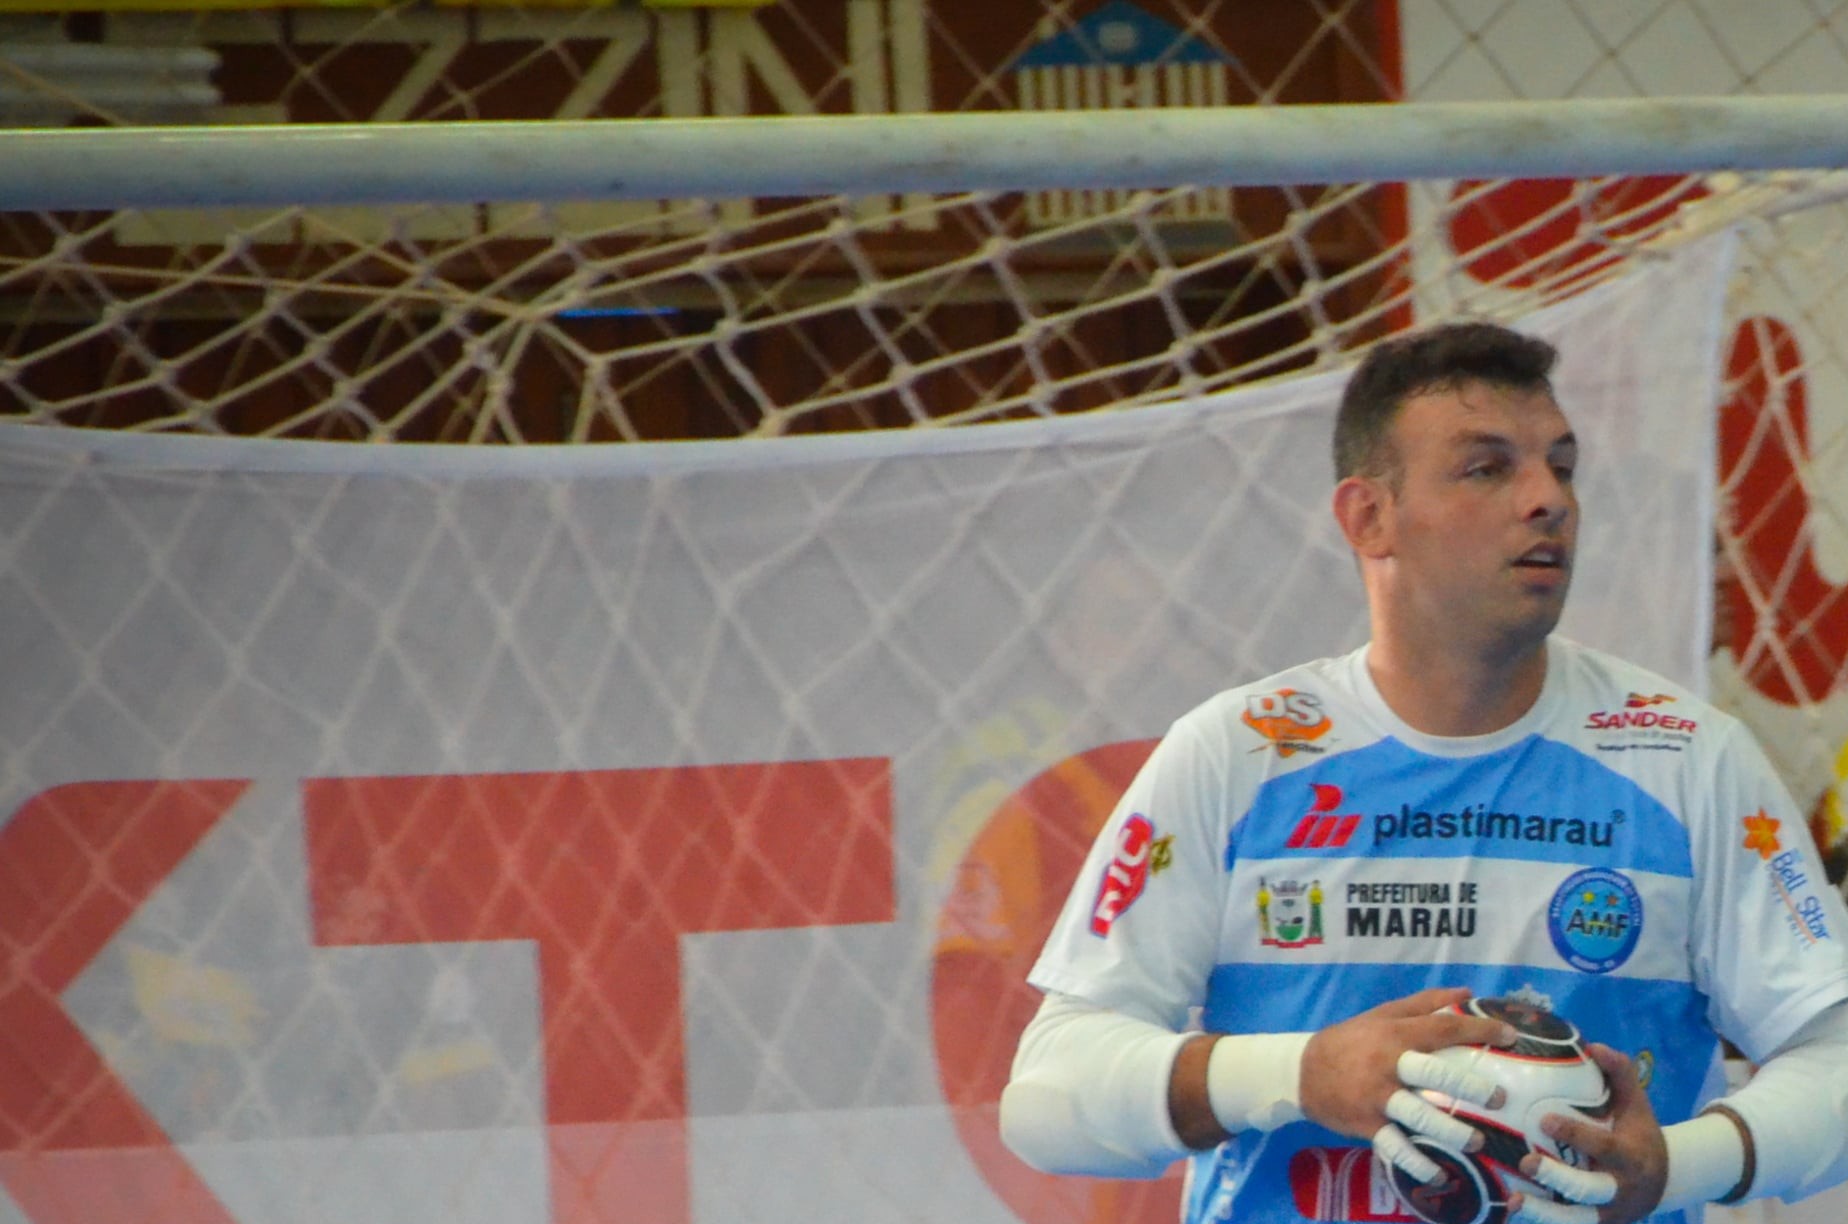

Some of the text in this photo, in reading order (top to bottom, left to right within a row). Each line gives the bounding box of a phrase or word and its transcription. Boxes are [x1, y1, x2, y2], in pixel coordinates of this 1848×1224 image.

[1584, 711, 1697, 733] SANDER
[1373, 804, 1613, 848] plastimarau
[1346, 882, 1478, 905] PREFEITURA DE
[1346, 908, 1477, 937] MARAU
